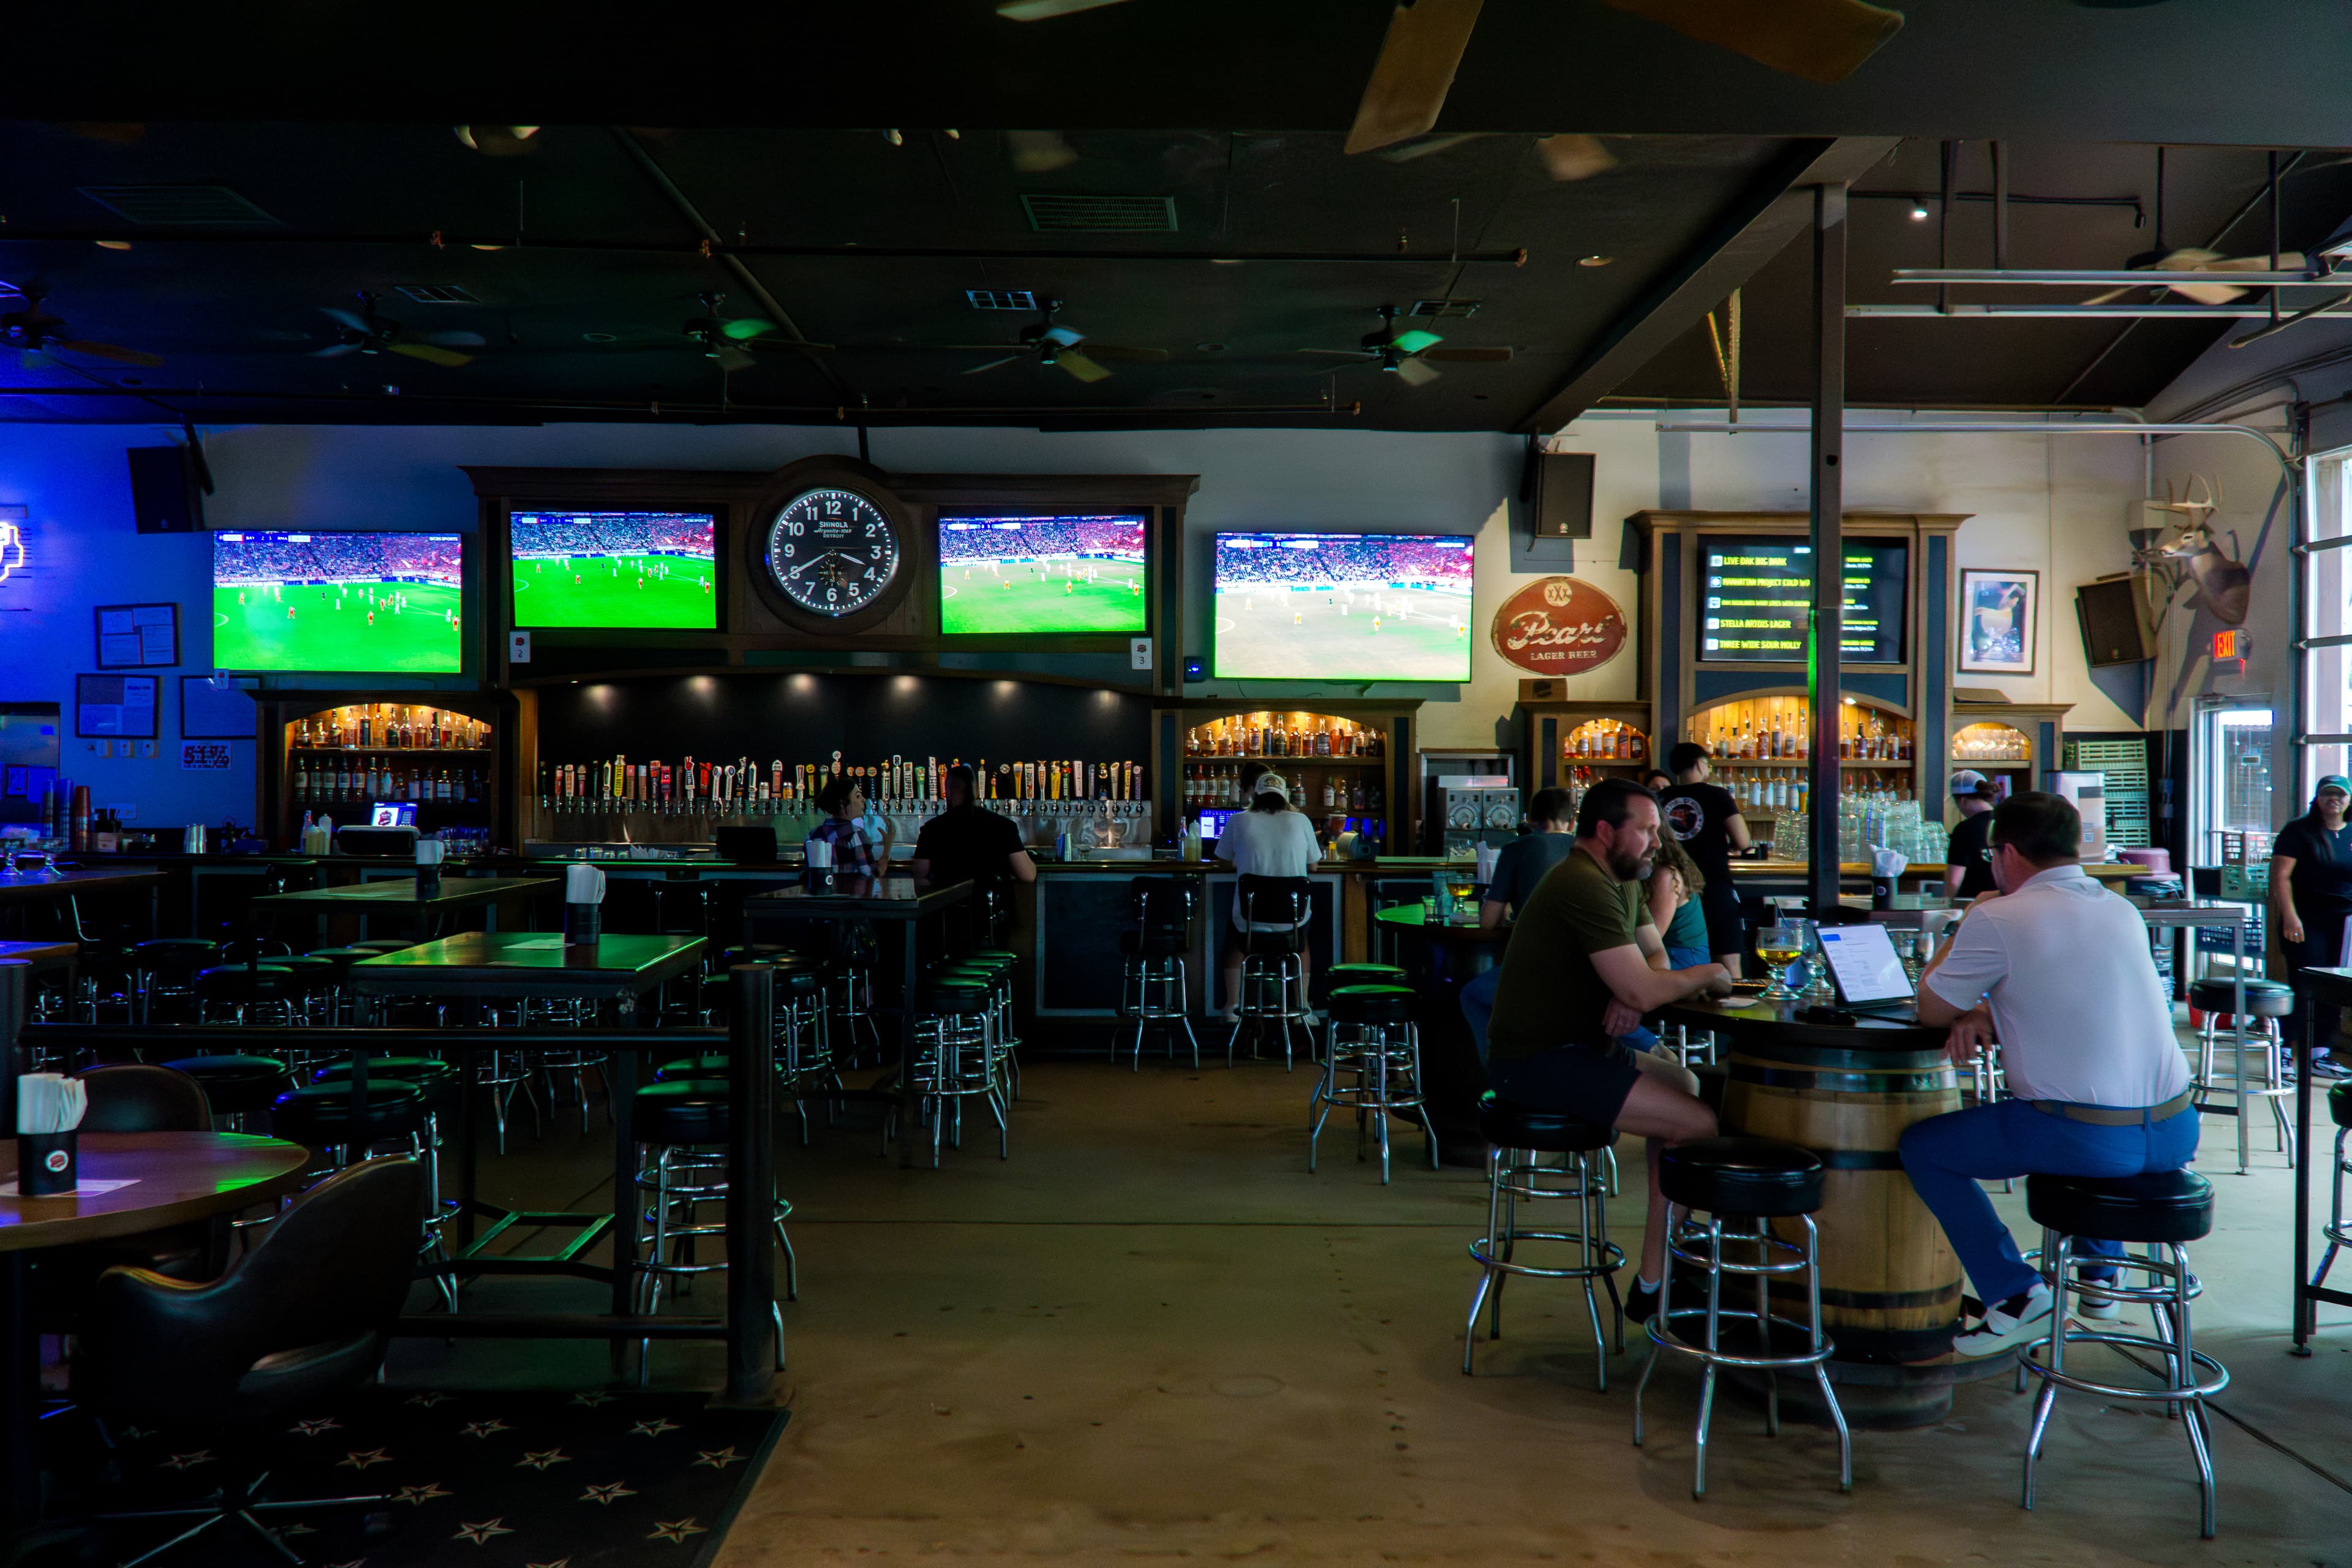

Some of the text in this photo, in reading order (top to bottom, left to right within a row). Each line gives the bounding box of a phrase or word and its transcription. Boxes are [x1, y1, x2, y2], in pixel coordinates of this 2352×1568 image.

[805, 507, 818, 521] 11
[825, 500, 842, 515] 12
[852, 507, 858, 521] 1
[788, 522, 805, 537] 10
[865, 523, 876, 538] 2
[784, 543, 795, 558] 9
[870, 545, 881, 560] 3
[1723, 556, 1739, 566] LIVE
[1755, 557, 1768, 566] BIG
[790, 566, 801, 579] 8
[864, 567, 876, 581] 4
[805, 582, 816, 595] 7
[848, 582, 859, 597] 5
[1757, 578, 1782, 587] PROJECT
[826, 587, 837, 602] 6
[1720, 619, 1792, 628] STELLA ARTOIS LAGER
[1719, 640, 1741, 649] THREE
[1741, 641, 1761, 649] WIDE
[1761, 641, 1781, 649] SOUR
[2217, 631, 2235, 658] EXIT
[516, 649, 523, 658] 2
[1530, 650, 1597, 661] LAGER BEER
[183, 745, 230, 768] 51%
